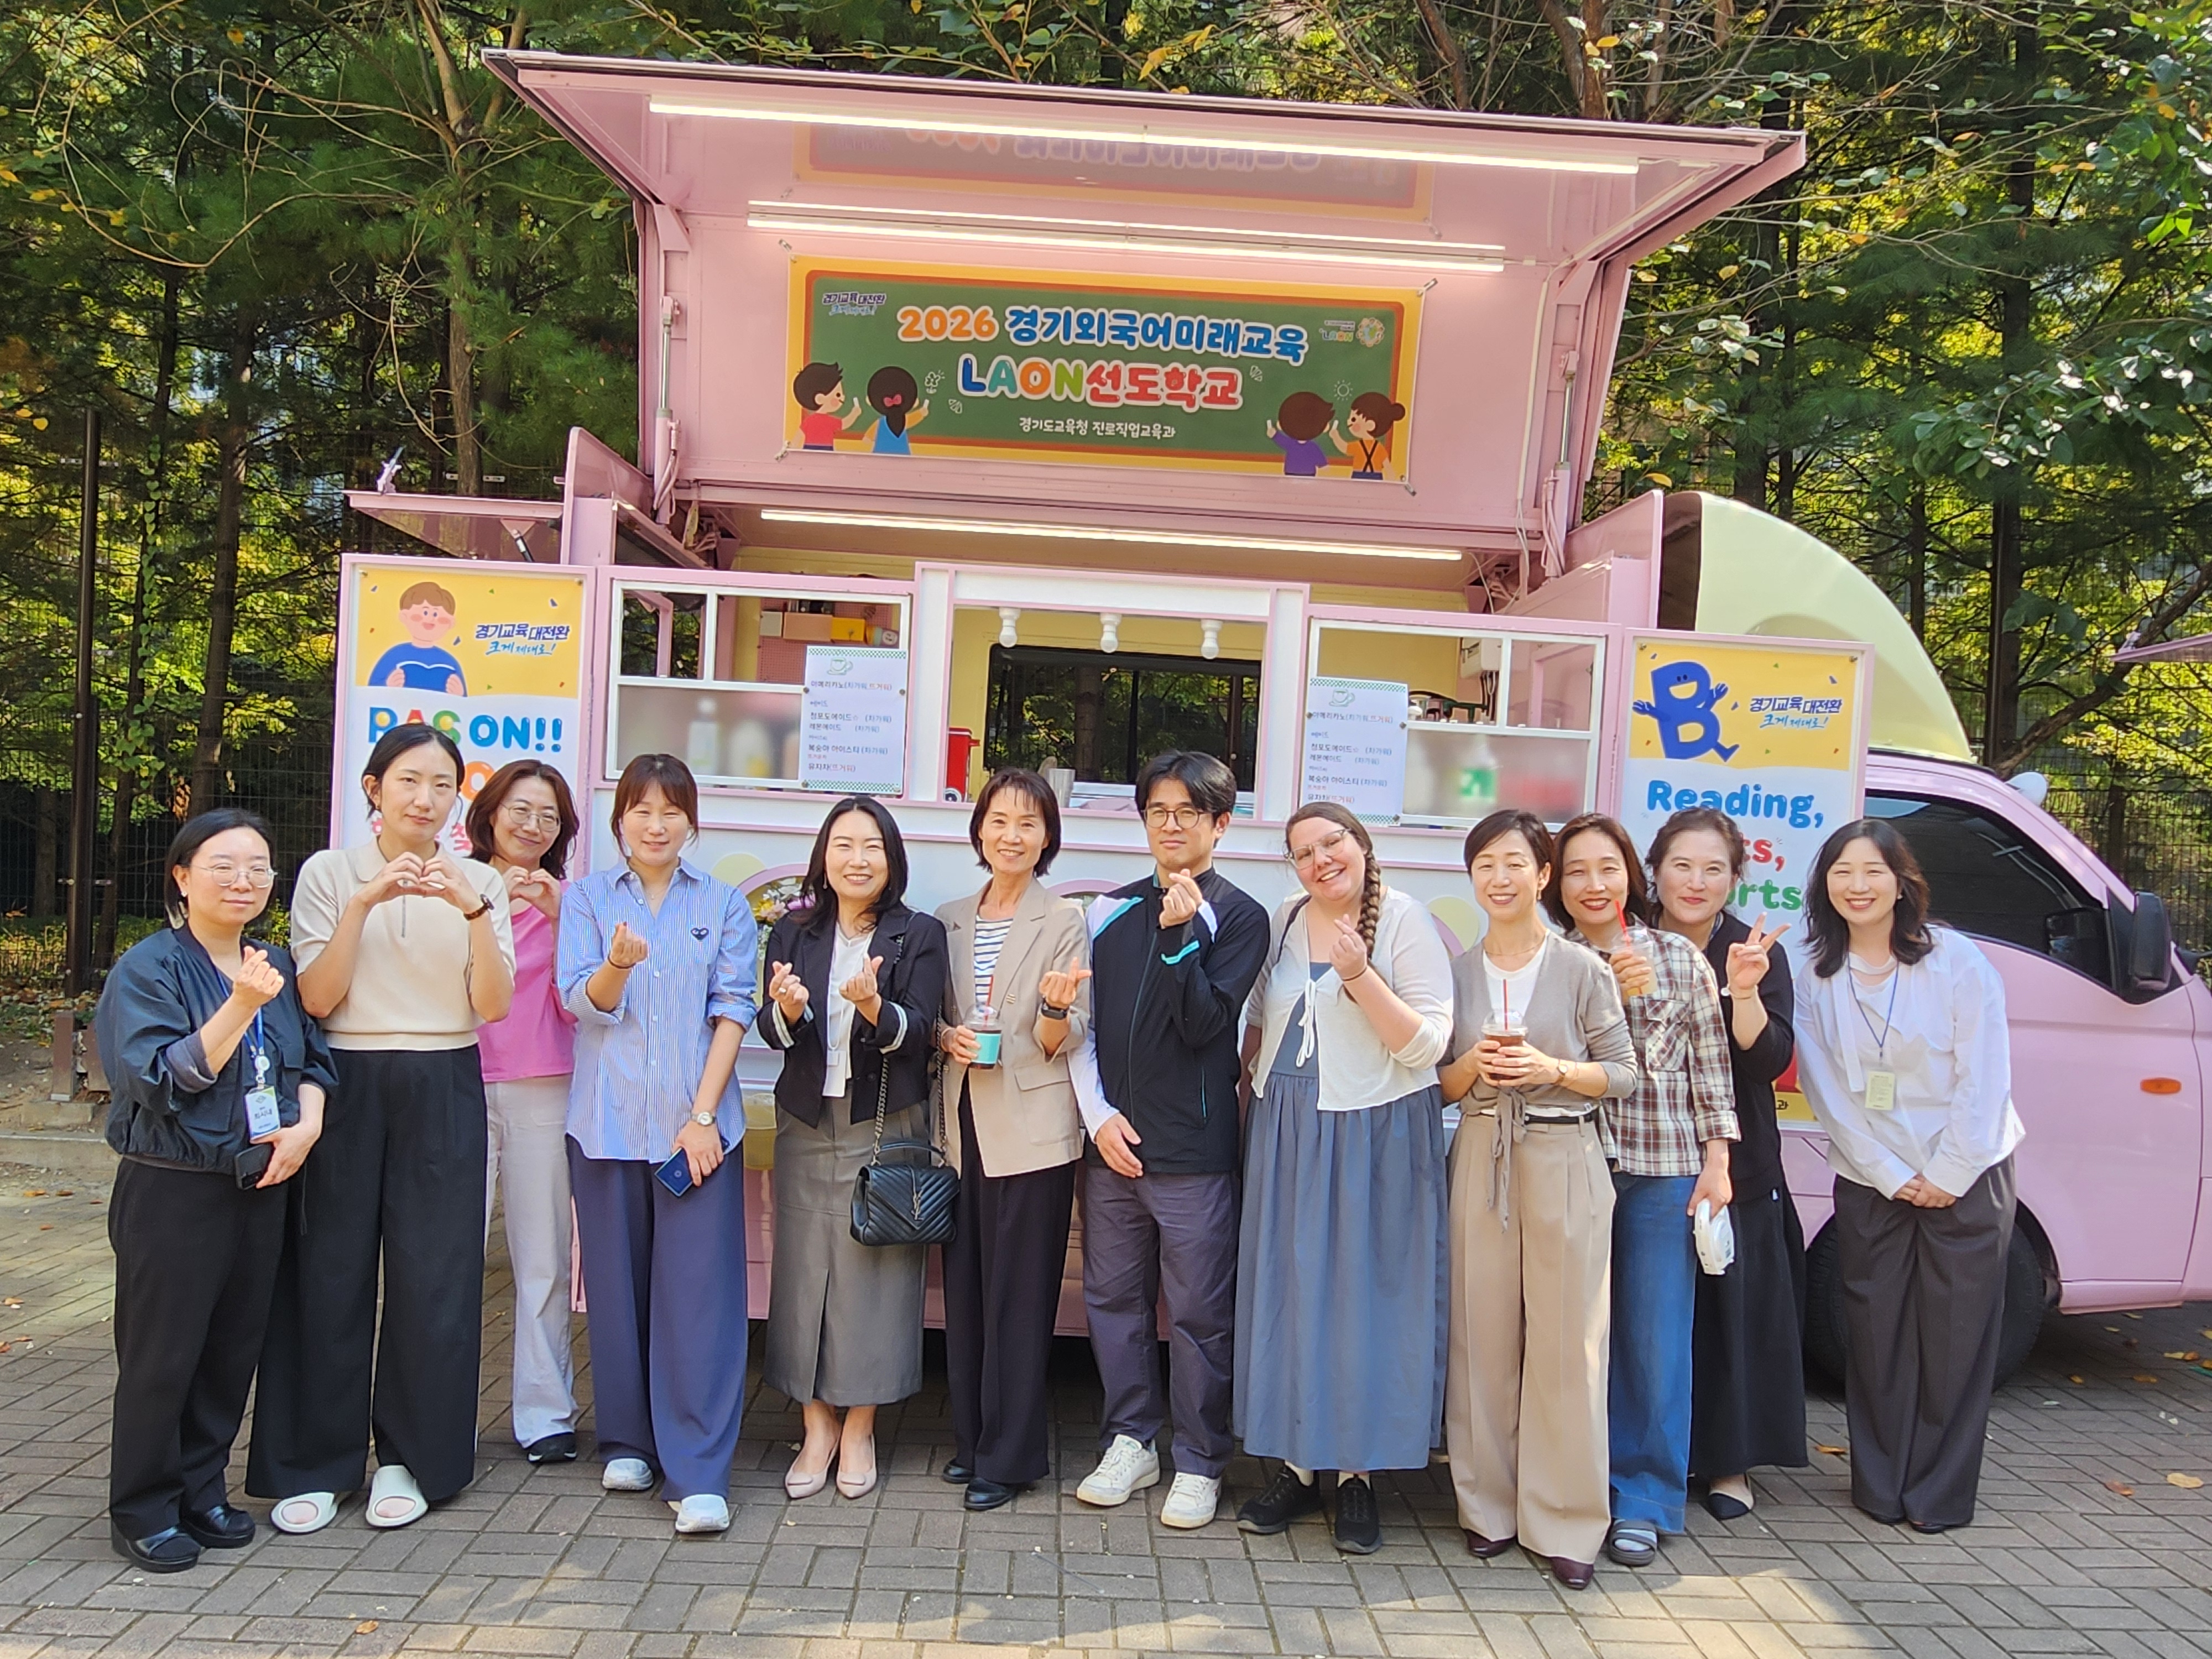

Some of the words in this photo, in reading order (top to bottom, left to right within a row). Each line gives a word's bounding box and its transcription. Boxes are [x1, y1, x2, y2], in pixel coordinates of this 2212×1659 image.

[899, 307, 997, 340] 2026
[1008, 308, 1307, 363] 경기외국어미래교육
[1019, 417, 1088, 436] 경기도교육청
[1092, 421, 1176, 440] 진로직업교육과
[808, 744, 829, 753] 복숭아
[831, 745, 860, 754] 아이스티
[1331, 776, 1359, 785] 아이스티
[1647, 780, 1824, 828] Reading,
